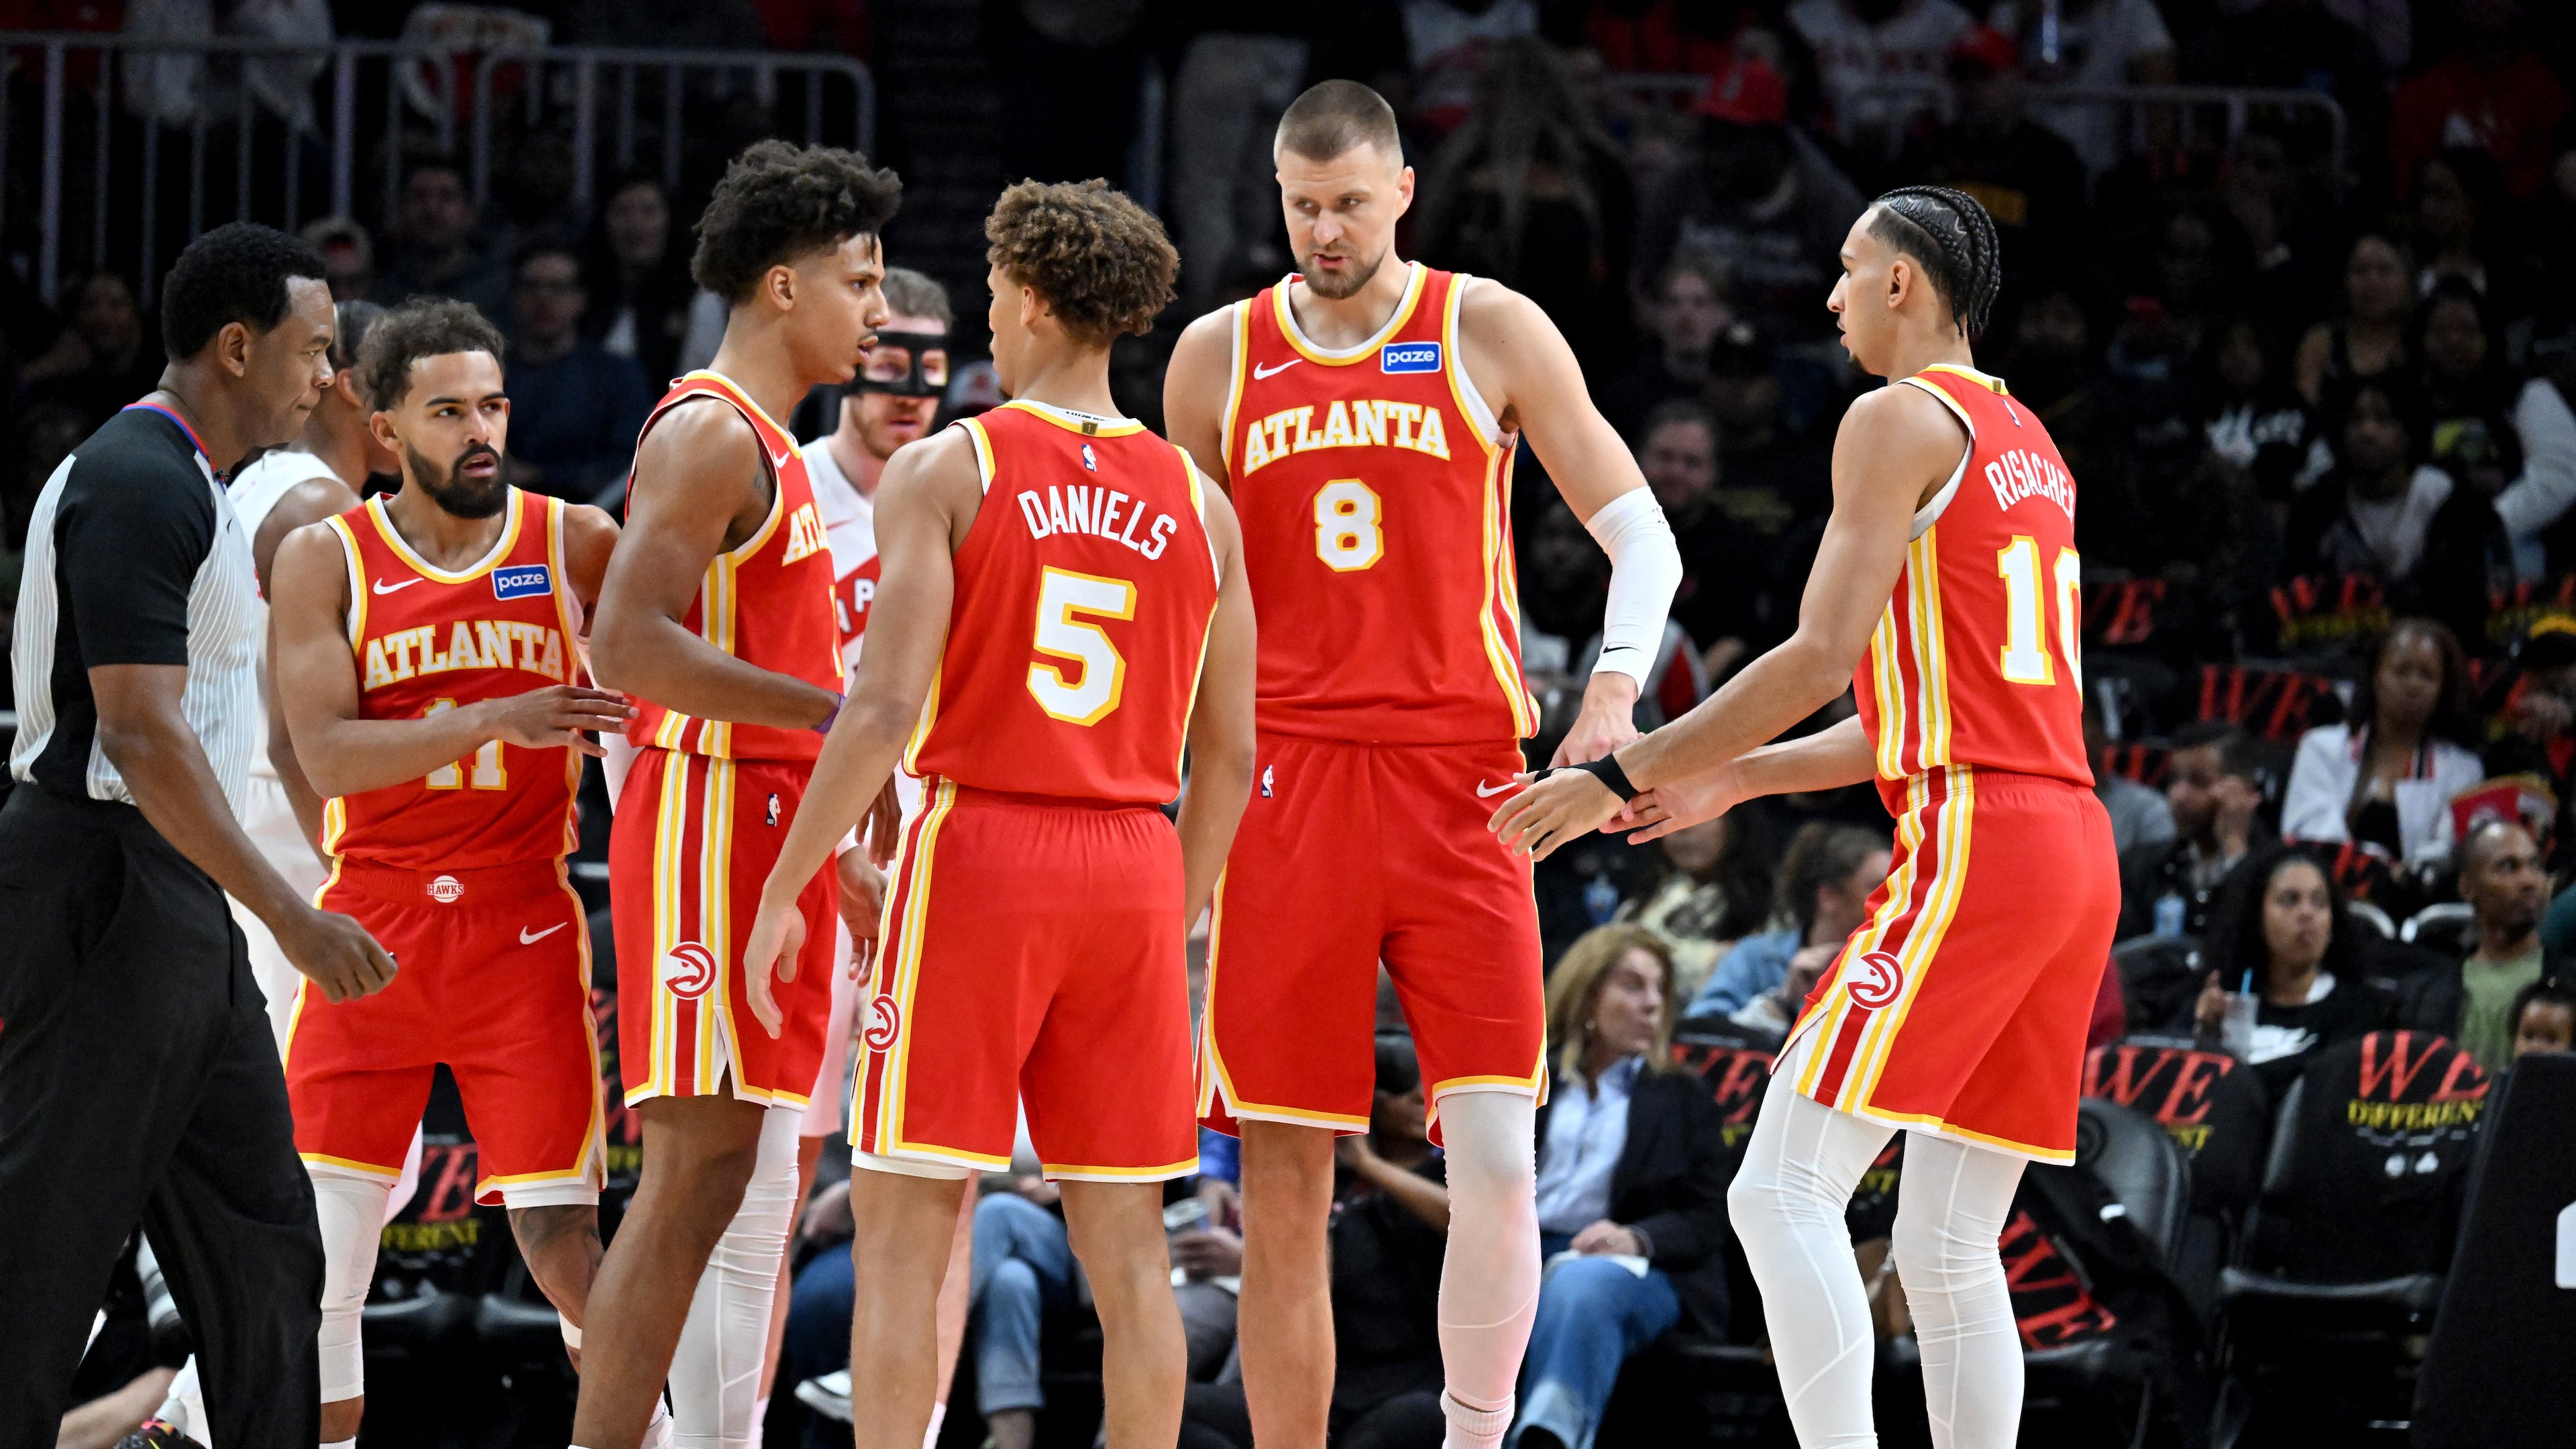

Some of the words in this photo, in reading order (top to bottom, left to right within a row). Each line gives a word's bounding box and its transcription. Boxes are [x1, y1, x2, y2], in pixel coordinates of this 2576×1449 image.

[1387, 350, 1436, 367] paze
[1244, 400, 1450, 478] ATLANTA
[1017, 485, 1178, 561] DANIELS
[1313, 478, 1385, 572] 8
[497, 573, 545, 592] paze
[364, 620, 564, 693] ATLANTA
[1026, 565, 1138, 728] 5
[427, 885, 464, 895] HAWKS
[2082, 1043, 2236, 1127] WE
